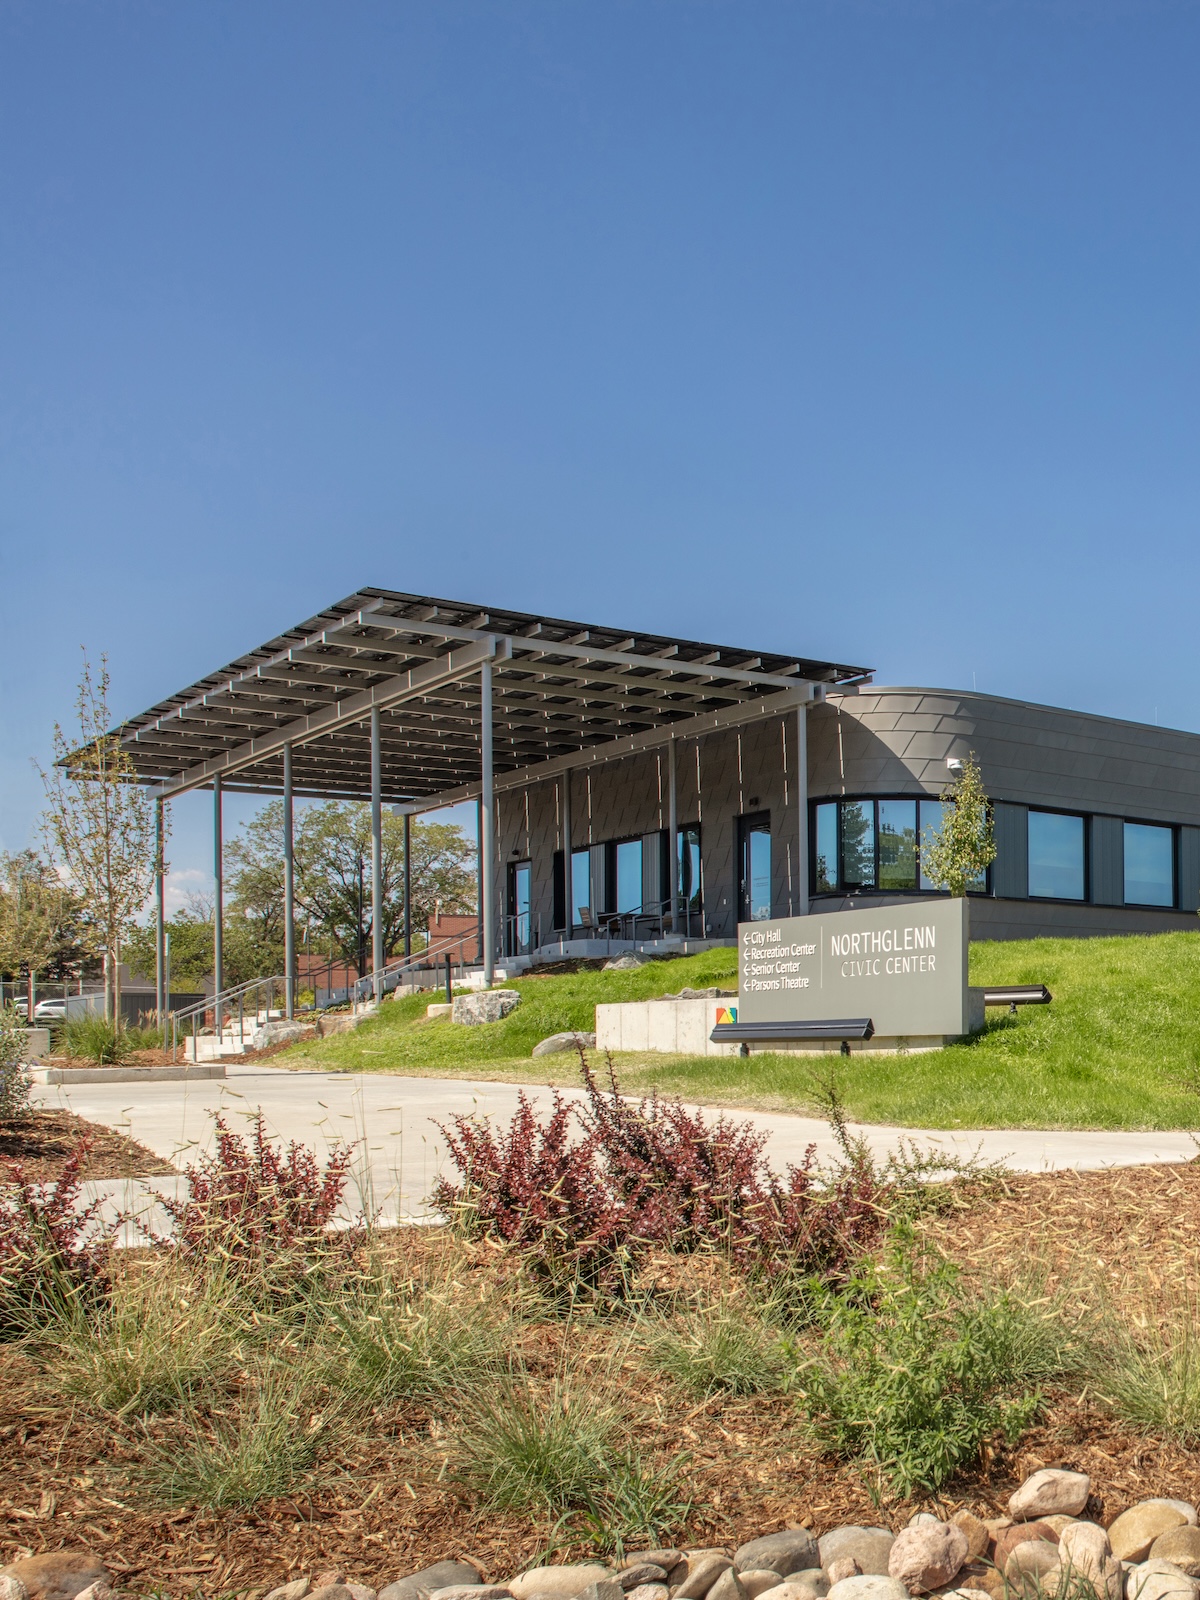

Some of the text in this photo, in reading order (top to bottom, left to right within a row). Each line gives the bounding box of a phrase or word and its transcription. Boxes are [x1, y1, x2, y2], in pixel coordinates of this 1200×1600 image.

[750, 928, 782, 947] City Hall
[831, 925, 936, 957] NORTHGLENN
[751, 943, 817, 960] Recreation Center
[751, 960, 801, 976] Senior Center
[841, 954, 936, 978] CIVIC CENTER
[751, 975, 810, 992] Parsons Theatre
